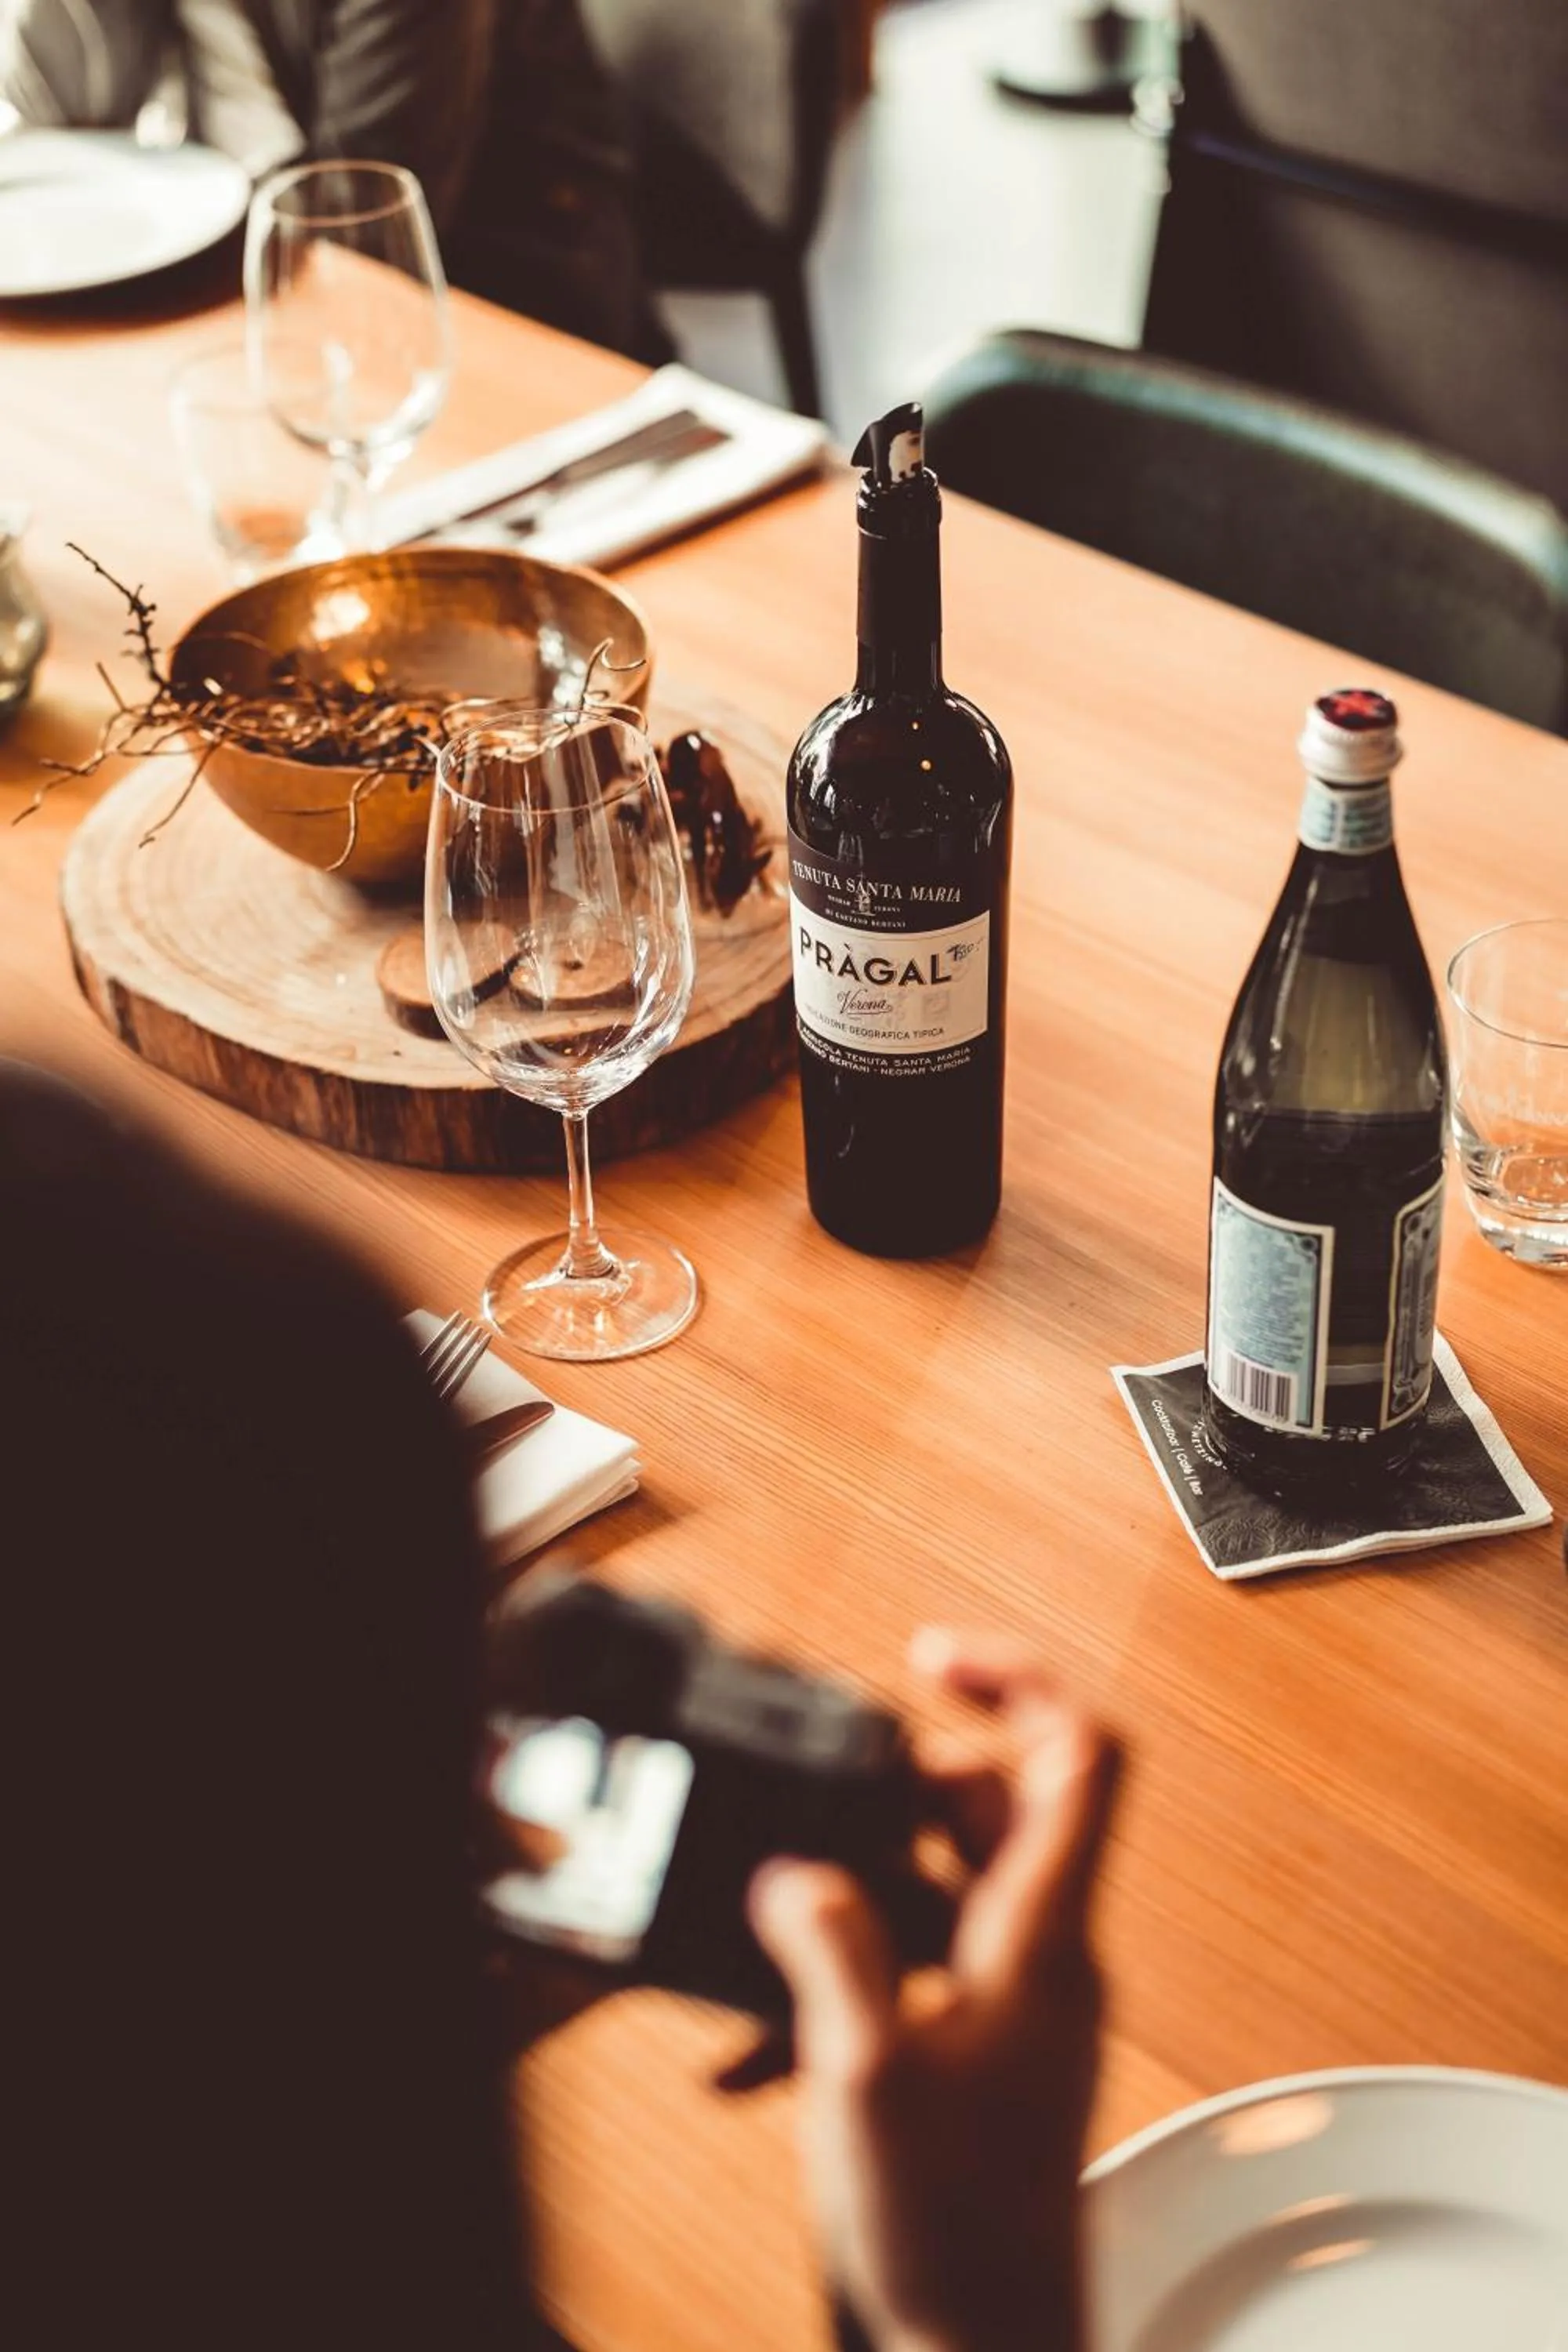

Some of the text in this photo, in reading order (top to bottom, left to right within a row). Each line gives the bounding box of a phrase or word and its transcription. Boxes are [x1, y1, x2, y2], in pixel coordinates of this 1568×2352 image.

[793, 860, 960, 902] TENUTA SANTA MARIA
[800, 926, 952, 986] PRÀGAL
[837, 988, 892, 1014] Verona
[849, 1025, 910, 1040] GEOGRAFICA
[913, 1028, 945, 1038] TIPICA
[845, 1051, 888, 1066] TENUTA
[894, 1058, 931, 1067] SANTA
[937, 1047, 971, 1062] MARIA
